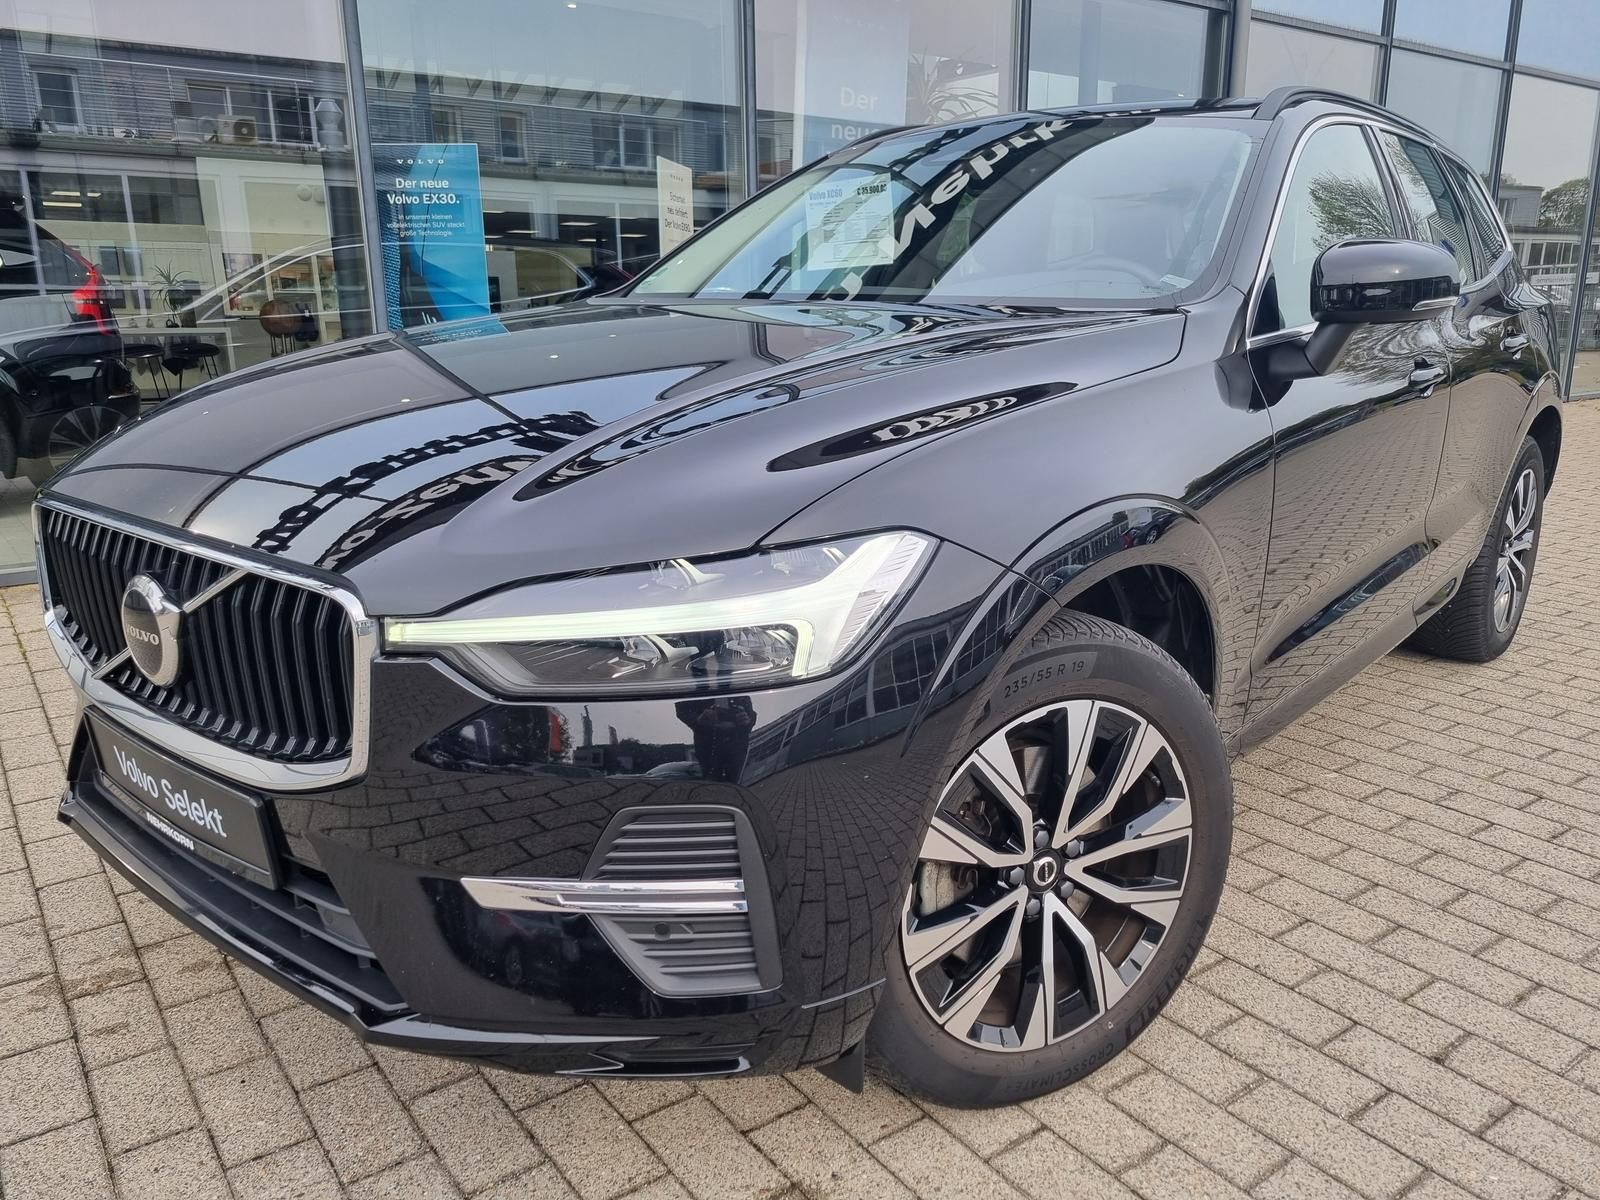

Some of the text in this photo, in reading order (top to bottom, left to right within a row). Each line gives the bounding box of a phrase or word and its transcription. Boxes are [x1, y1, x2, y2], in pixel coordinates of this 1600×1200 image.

[839, 87, 878, 111] Der
[395, 178, 449, 189] Der neue
[387, 193, 460, 205] Volvo EX30.
[126, 624, 160, 645] VOLVO
[1004, 660, 1085, 698] 235/55 R 19
[113, 745, 228, 838] Volvo Selekt
[146, 811, 195, 850] NEHRKORN
